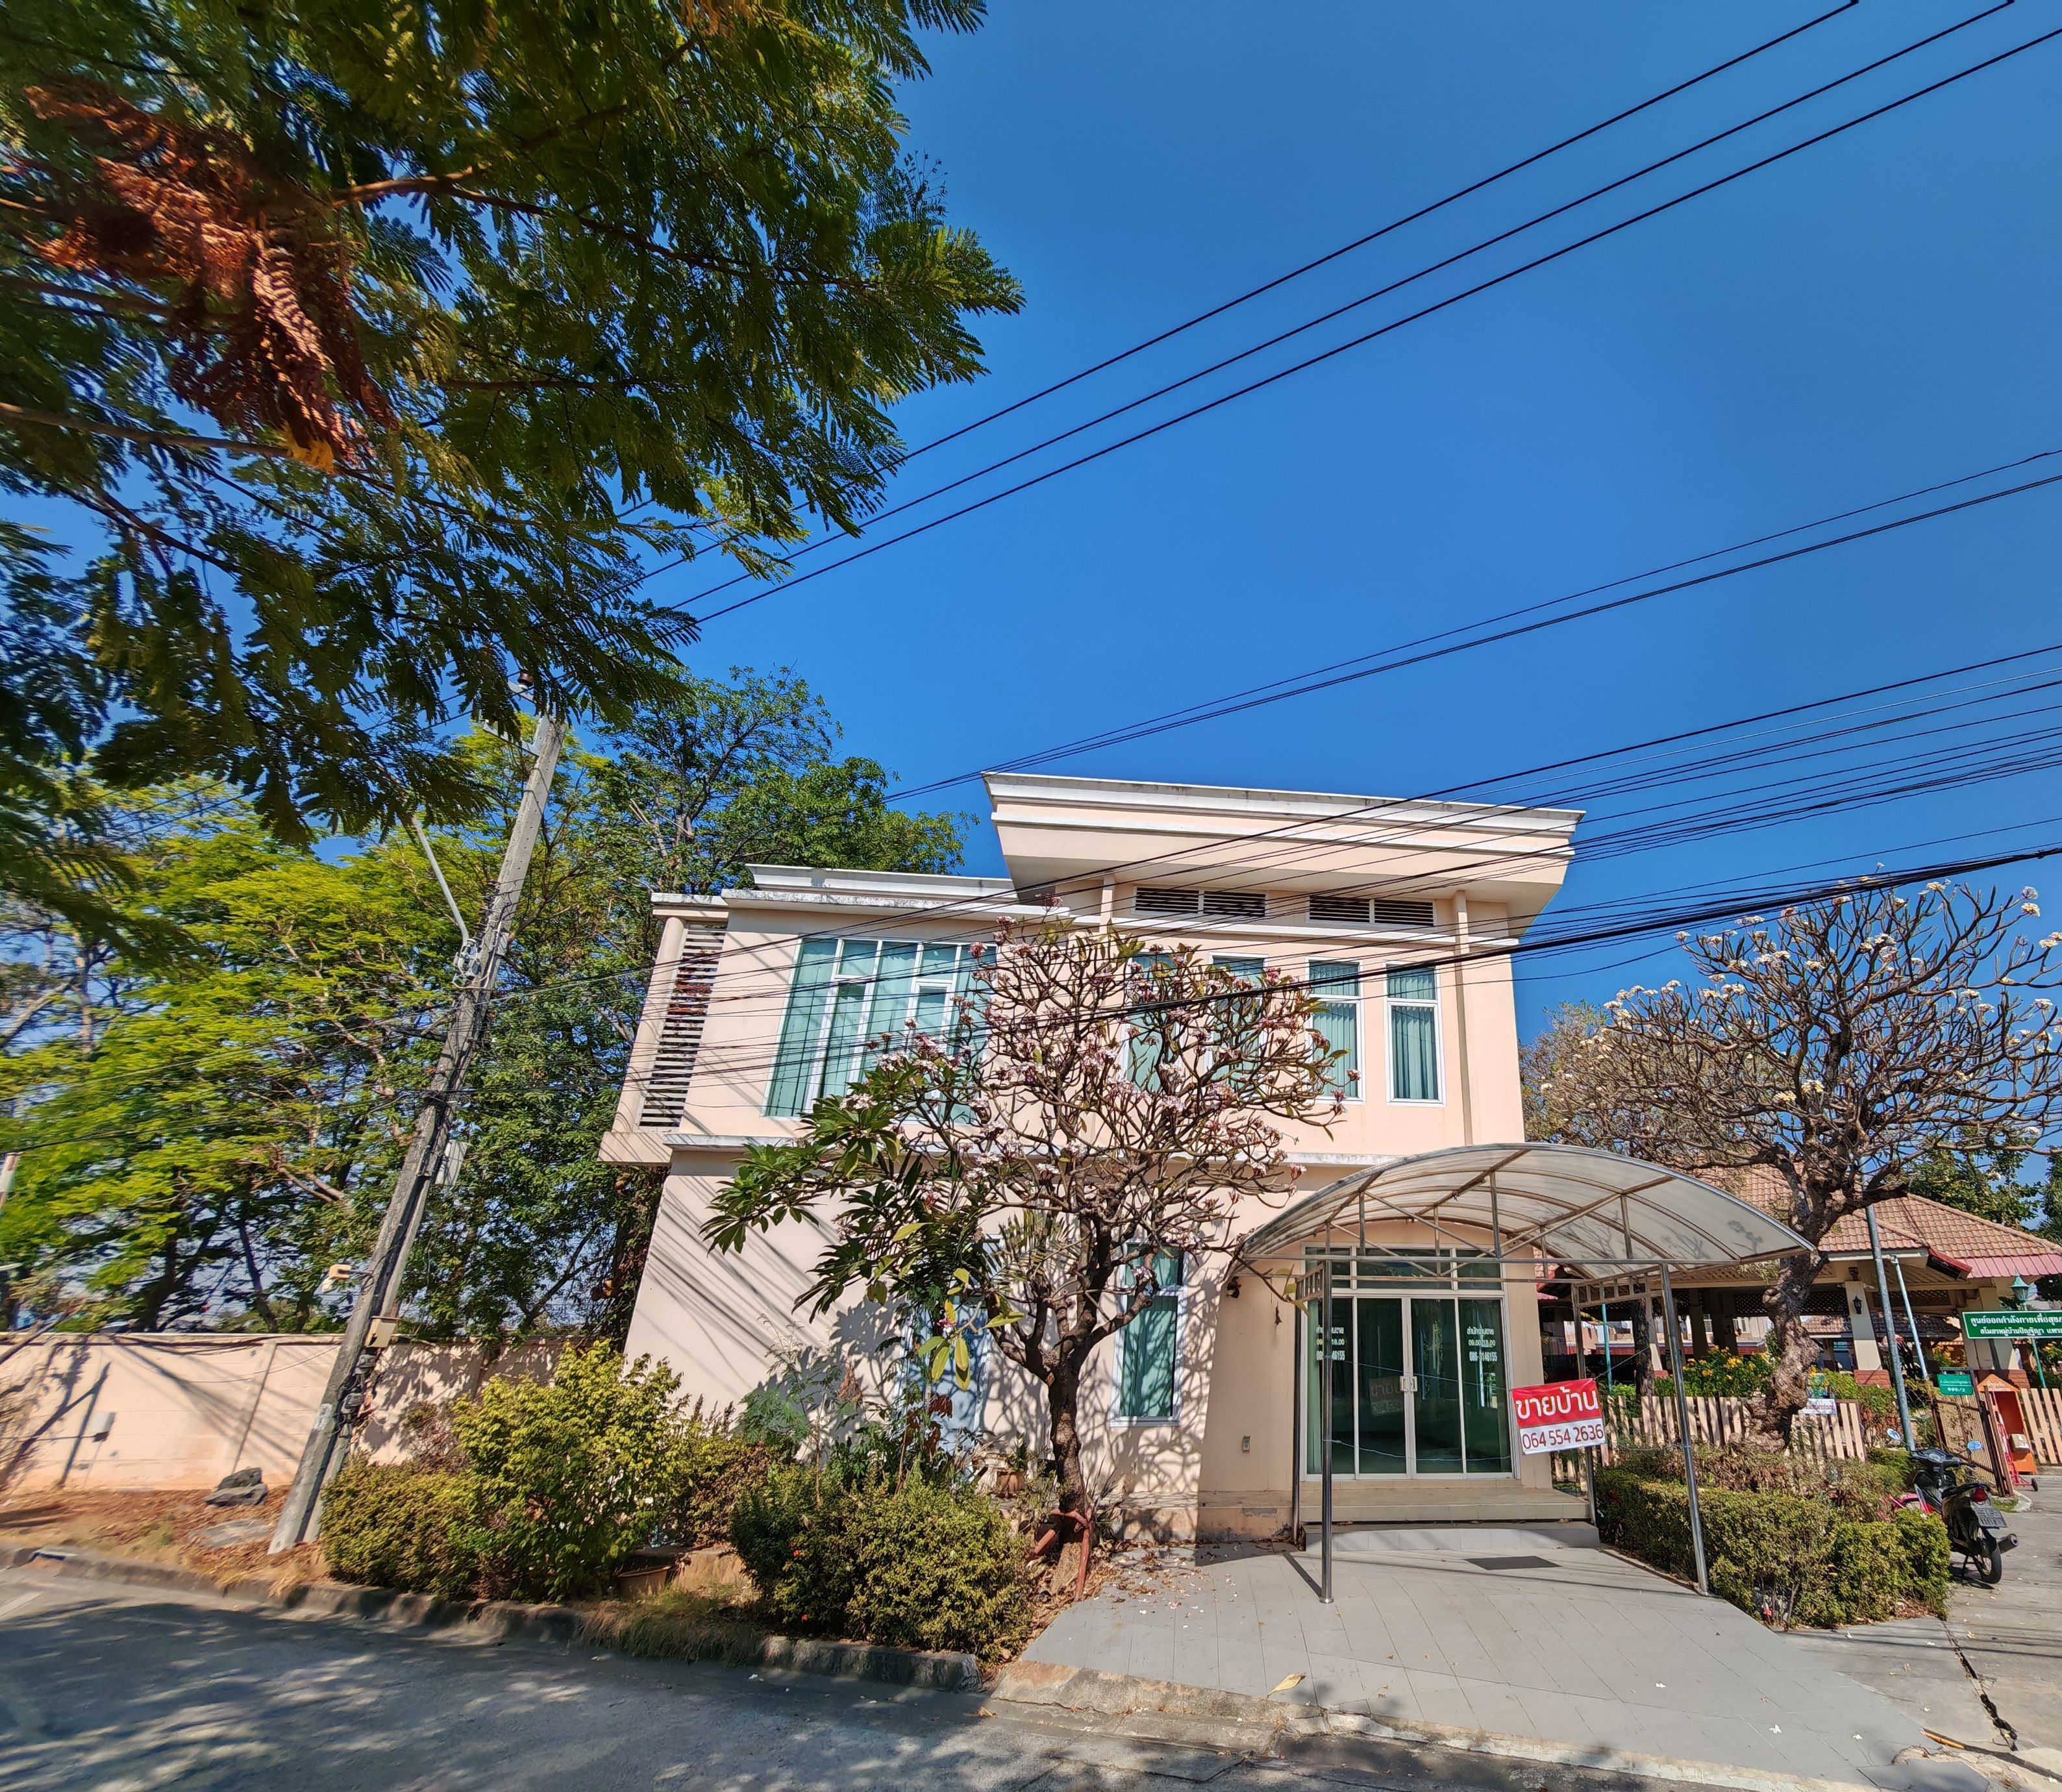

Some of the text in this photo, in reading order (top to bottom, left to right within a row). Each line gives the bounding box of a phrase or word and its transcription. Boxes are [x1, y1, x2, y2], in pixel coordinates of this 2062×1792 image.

[1515, 1386, 1599, 1419] ขายบ้าน
[1522, 1424, 1604, 1449] 064 554 2636
